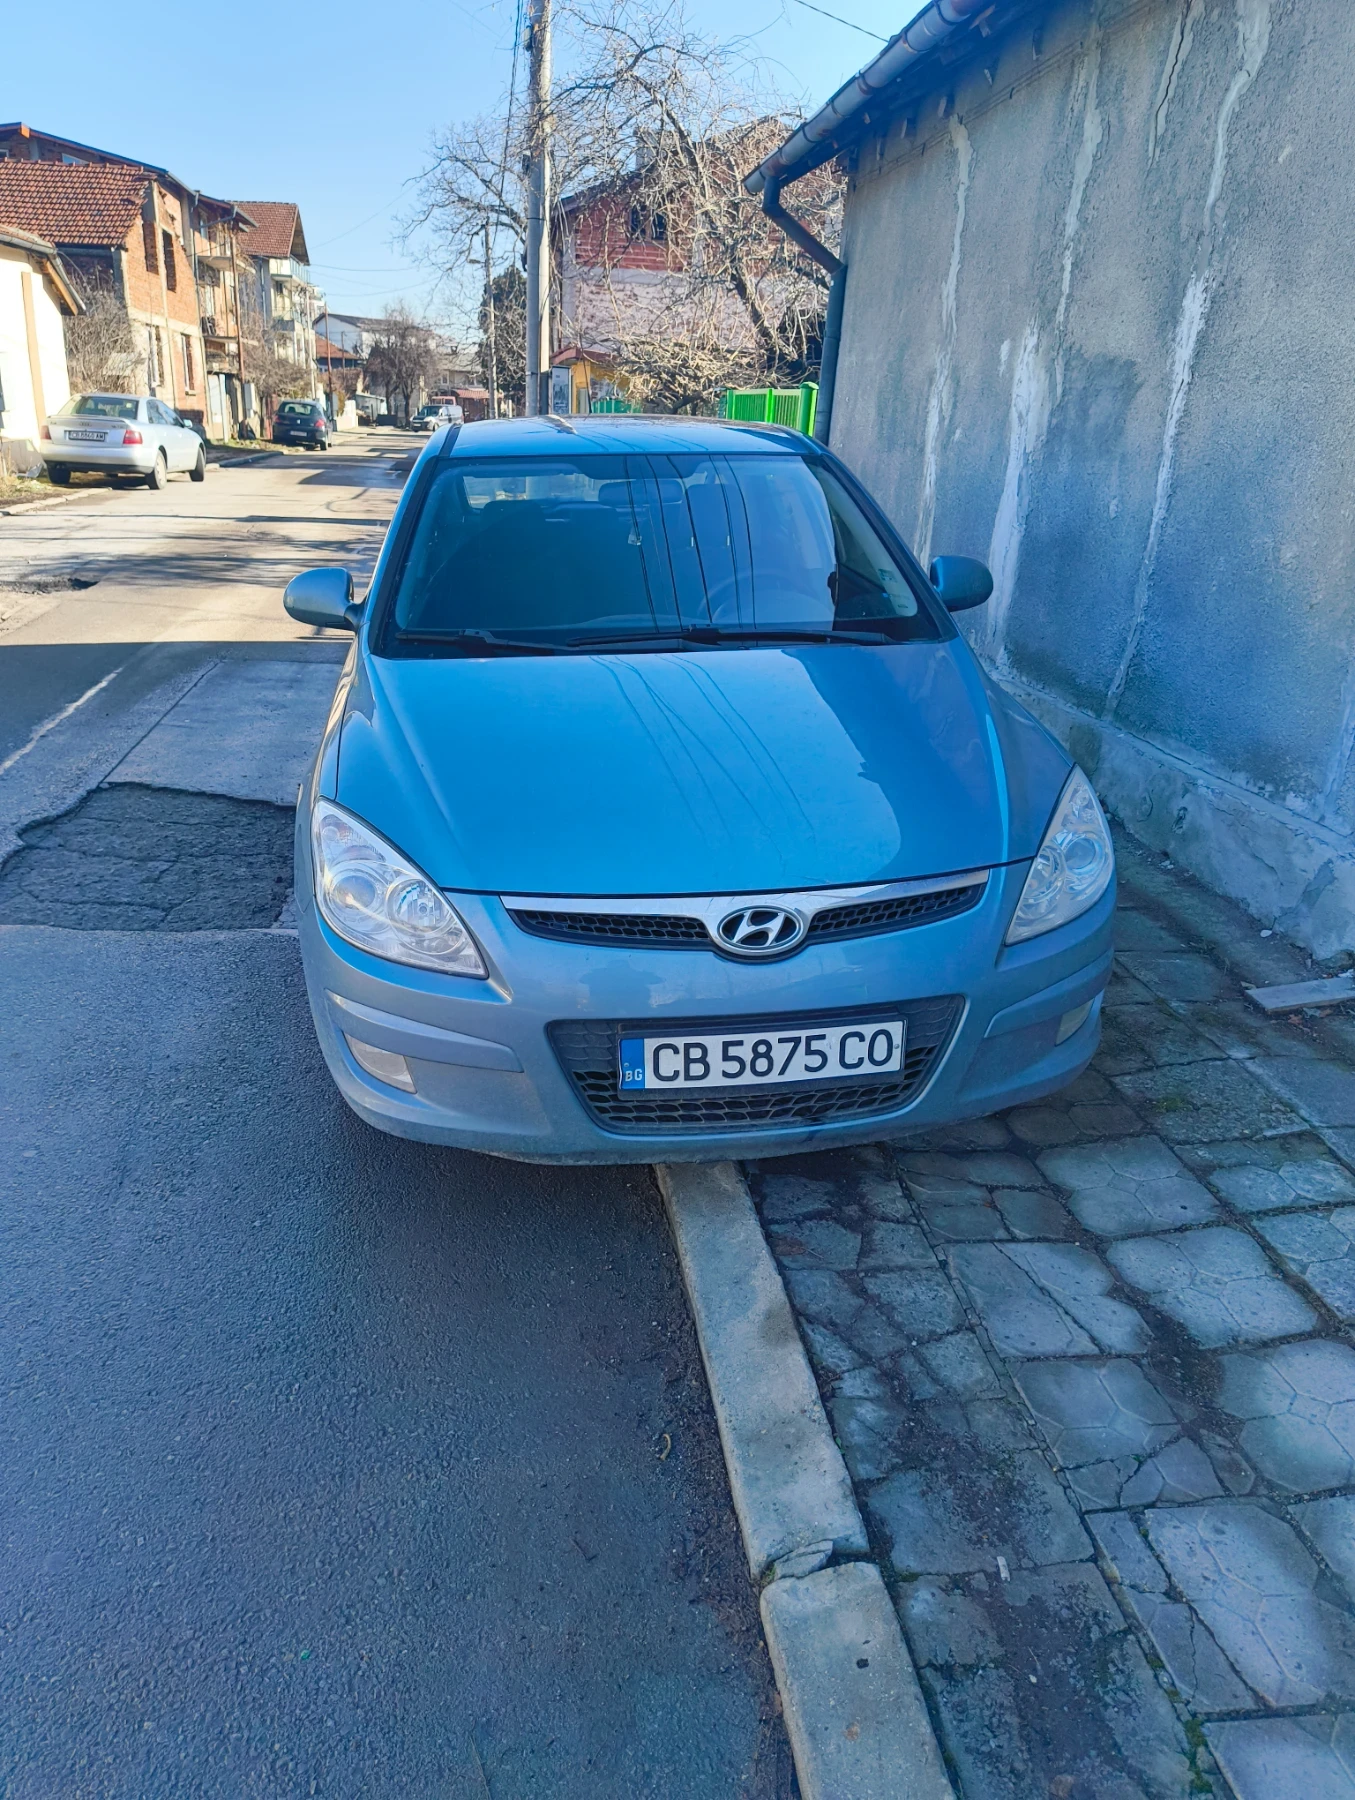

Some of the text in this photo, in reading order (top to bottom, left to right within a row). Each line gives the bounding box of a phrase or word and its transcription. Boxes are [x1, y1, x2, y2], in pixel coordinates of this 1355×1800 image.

[653, 1029, 893, 1082] CB 5875 CO
[625, 1068, 643, 1082] BG
